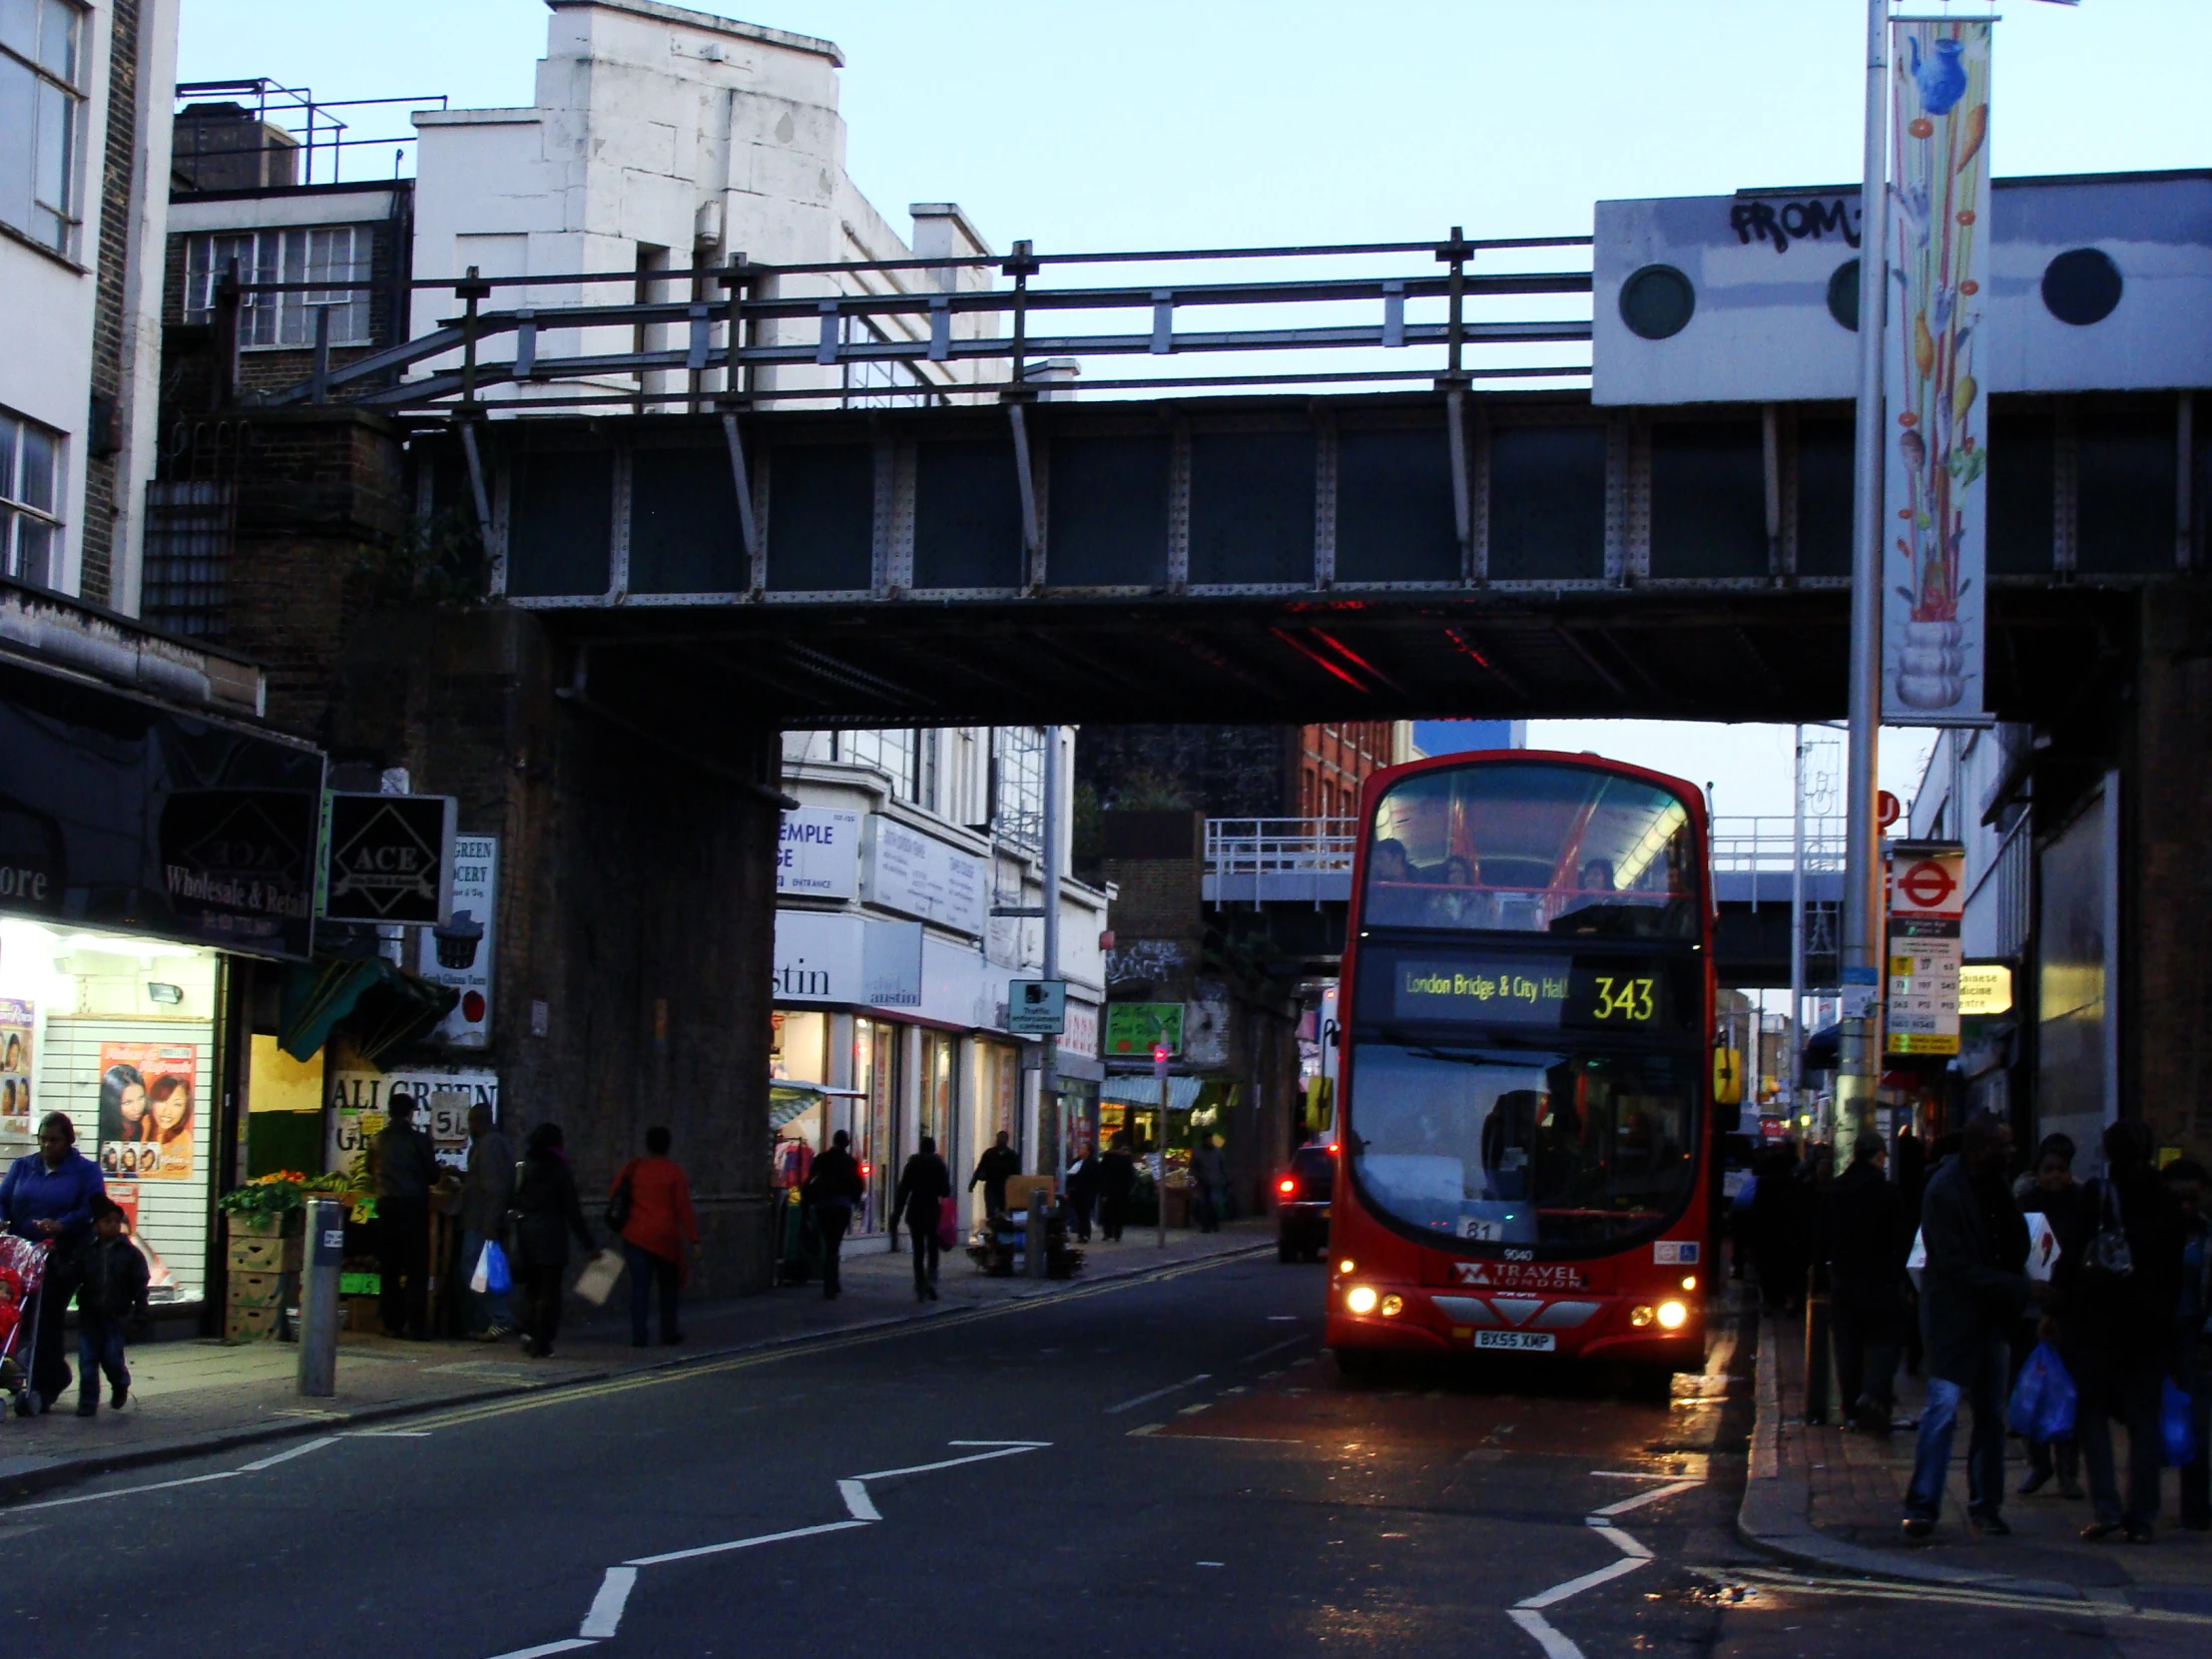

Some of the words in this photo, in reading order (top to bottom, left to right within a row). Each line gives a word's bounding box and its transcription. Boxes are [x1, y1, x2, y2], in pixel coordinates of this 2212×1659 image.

[353, 845, 419, 871] ACE
[0, 865, 48, 900] ore
[165, 863, 247, 908] Wholesale
[249, 879, 263, 911] &
[266, 884, 309, 918] Retail
[793, 877, 831, 888] ENTRANCE
[773, 957, 830, 995] stin
[870, 989, 916, 1004] austin
[1405, 972, 1451, 995] London
[1454, 973, 1495, 1001] Bridge
[1499, 974, 1510, 996] &
[1513, 975, 1538, 1004] City
[1542, 977, 1569, 999] Hall
[1593, 976, 1655, 1021] 343
[331, 1079, 380, 1110] ALI
[1466, 1221, 1491, 1241] 81
[1503, 1248, 1534, 1262] 9040
[1492, 1277, 1582, 1289] LONDON
[1493, 1264, 1580, 1281] TRAVEL
[1480, 1333, 1517, 1347] BX55
[1520, 1334, 1549, 1349] XMP
